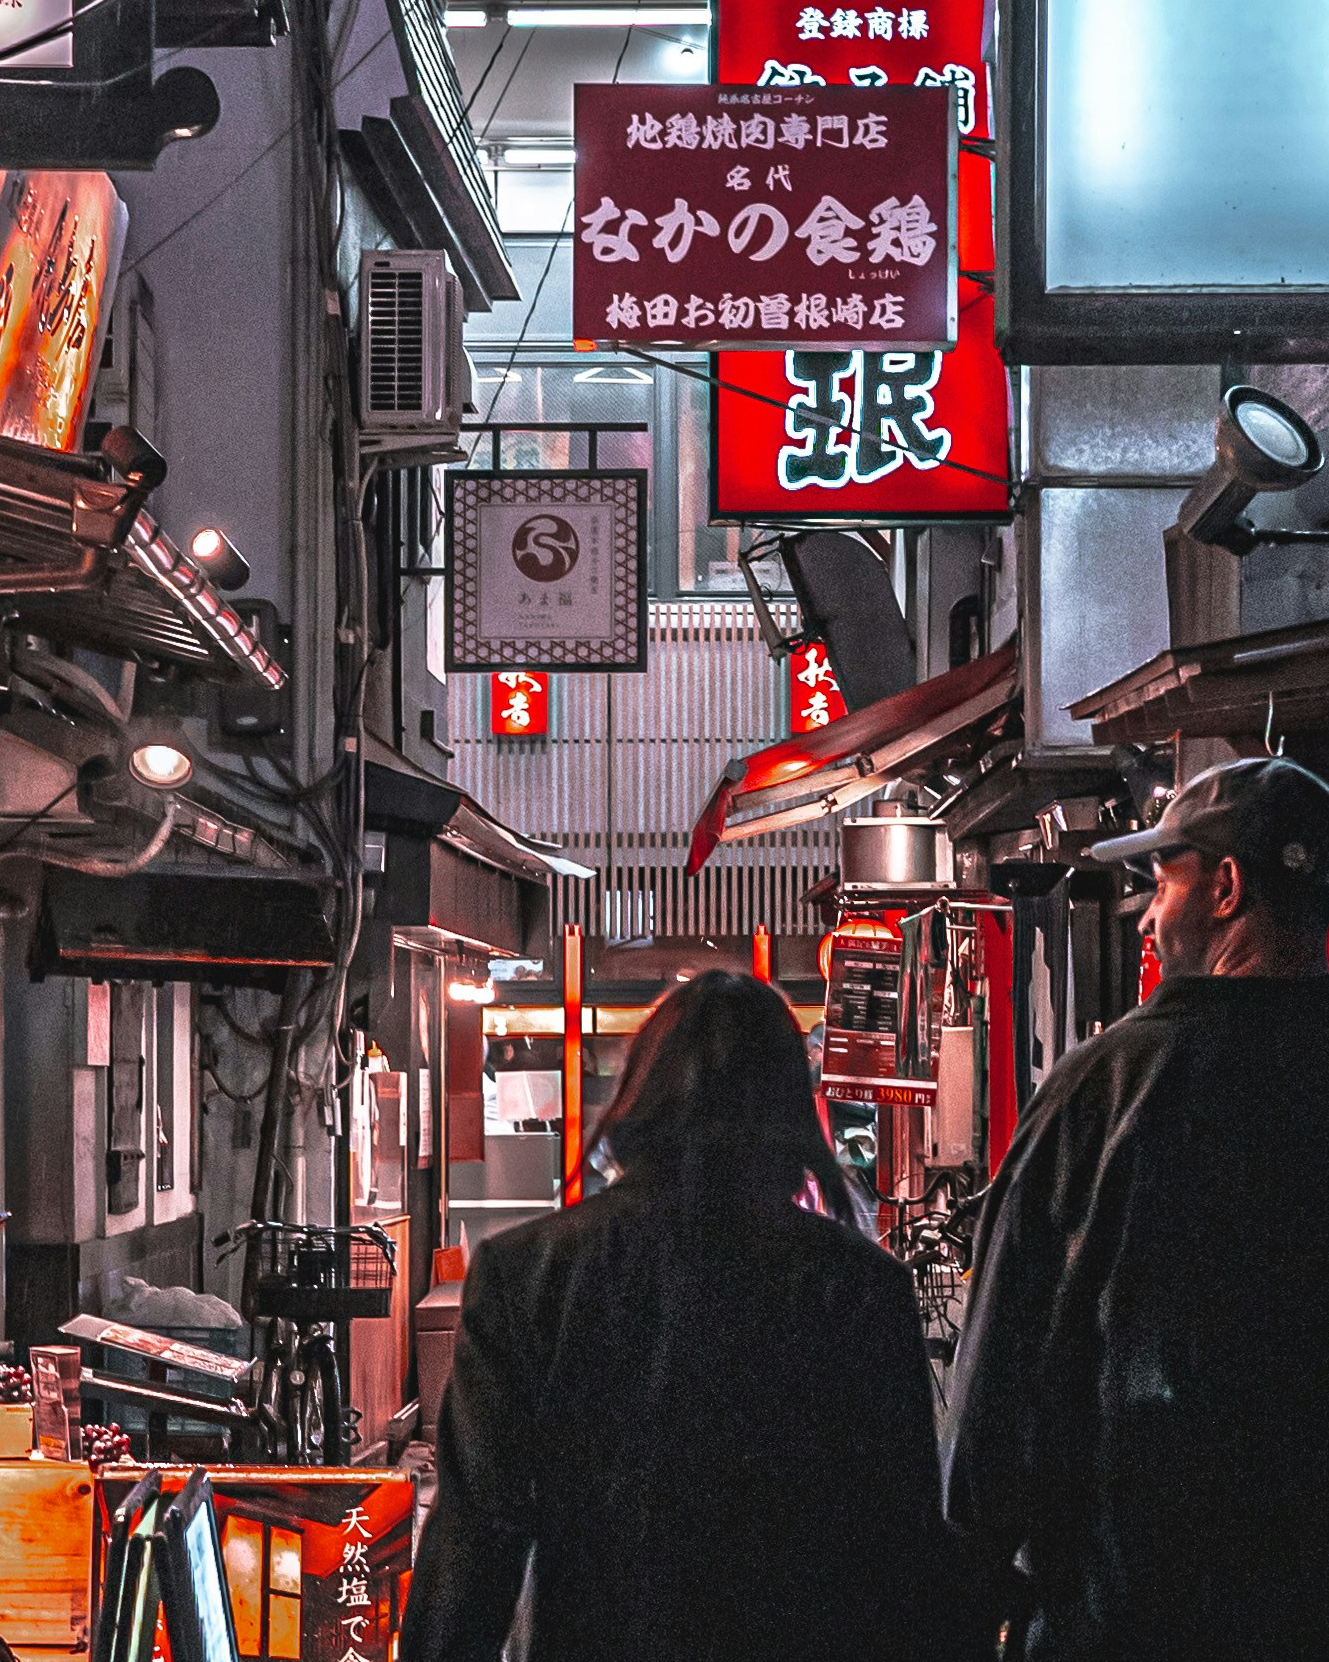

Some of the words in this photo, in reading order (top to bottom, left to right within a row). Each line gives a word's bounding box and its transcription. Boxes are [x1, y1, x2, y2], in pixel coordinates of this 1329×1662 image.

[795, 8, 929, 41] 登録商標
[626, 111, 889, 151] 地鶏焼肉専門店
[725, 164, 793, 192] 名代
[581, 194, 938, 267] なかの食鶏
